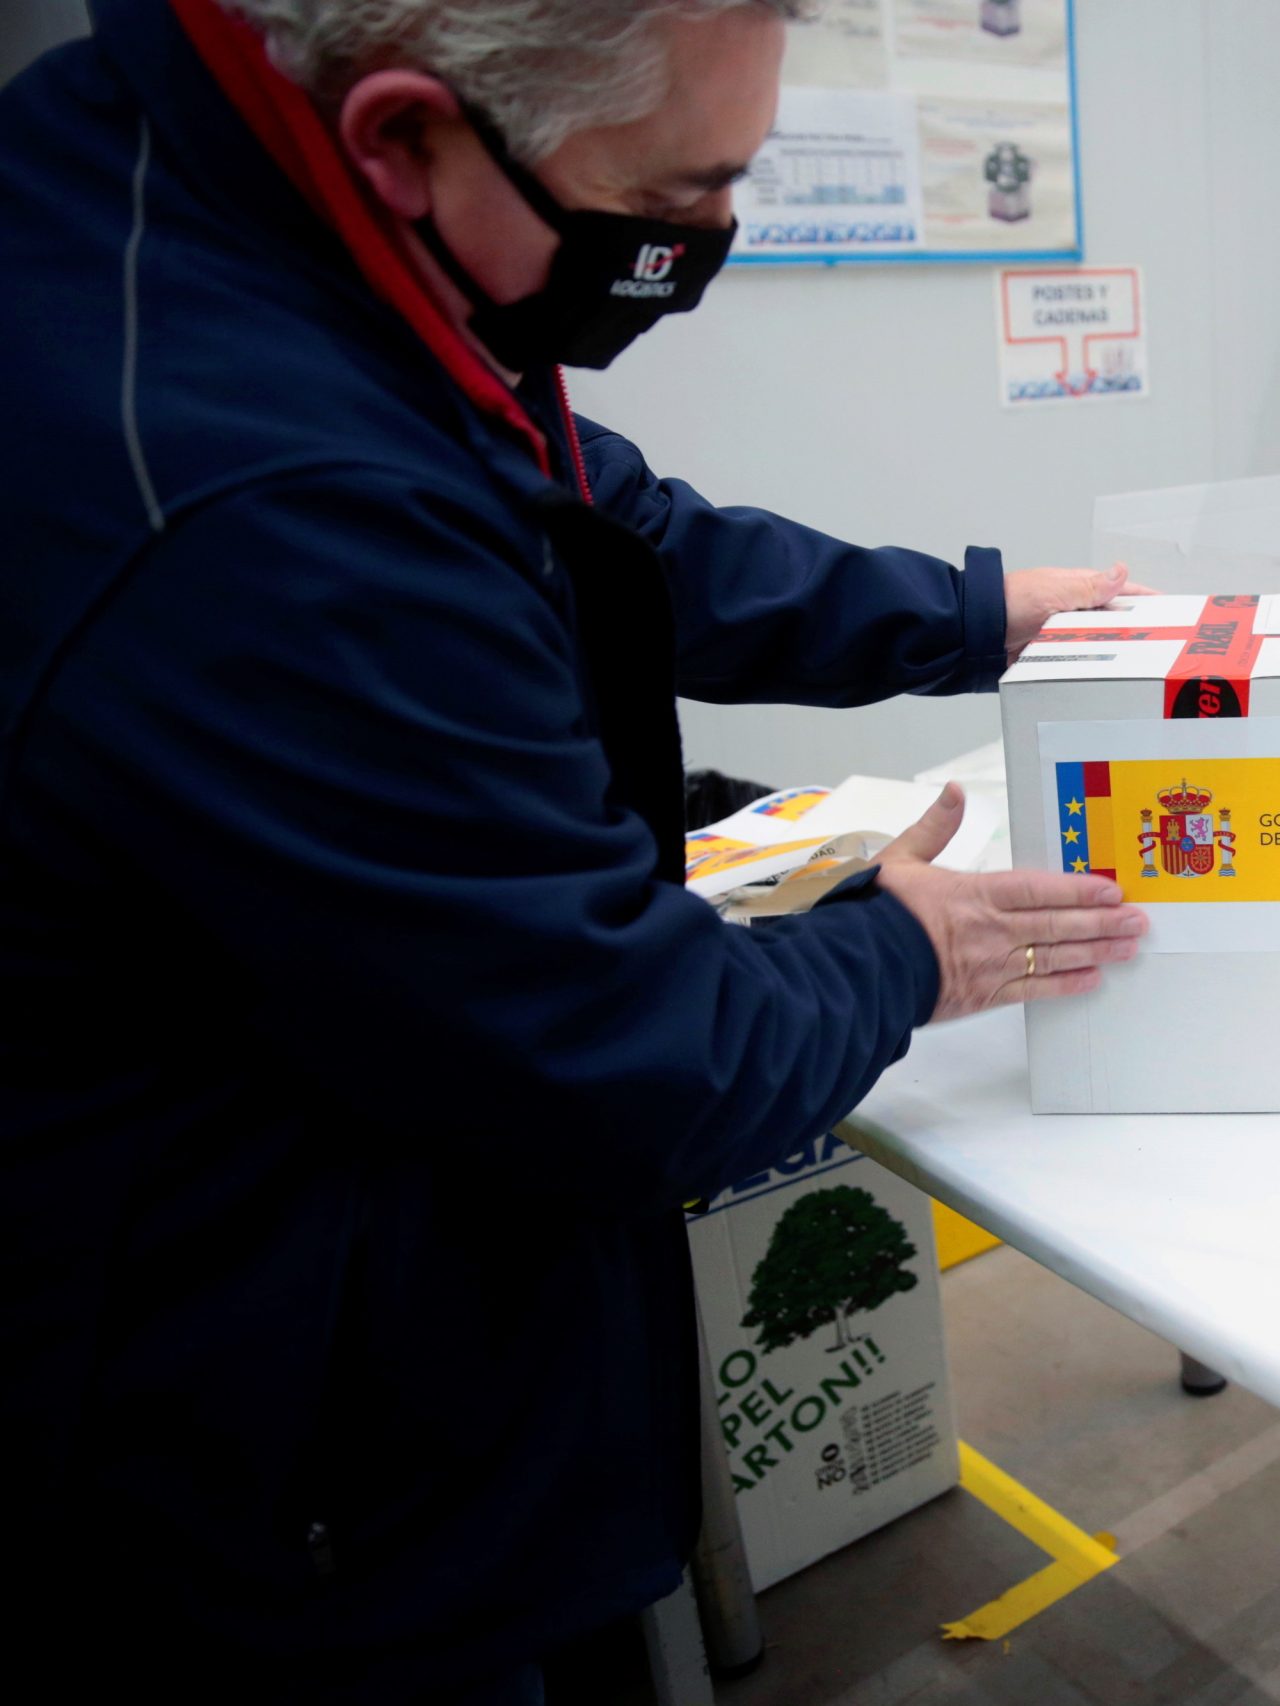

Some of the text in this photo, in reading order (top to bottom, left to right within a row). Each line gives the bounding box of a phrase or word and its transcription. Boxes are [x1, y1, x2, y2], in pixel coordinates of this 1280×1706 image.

[633, 243, 674, 281] ID
[721, 1379, 795, 1450] PEL
[731, 1337, 886, 1494] ARTON!!
